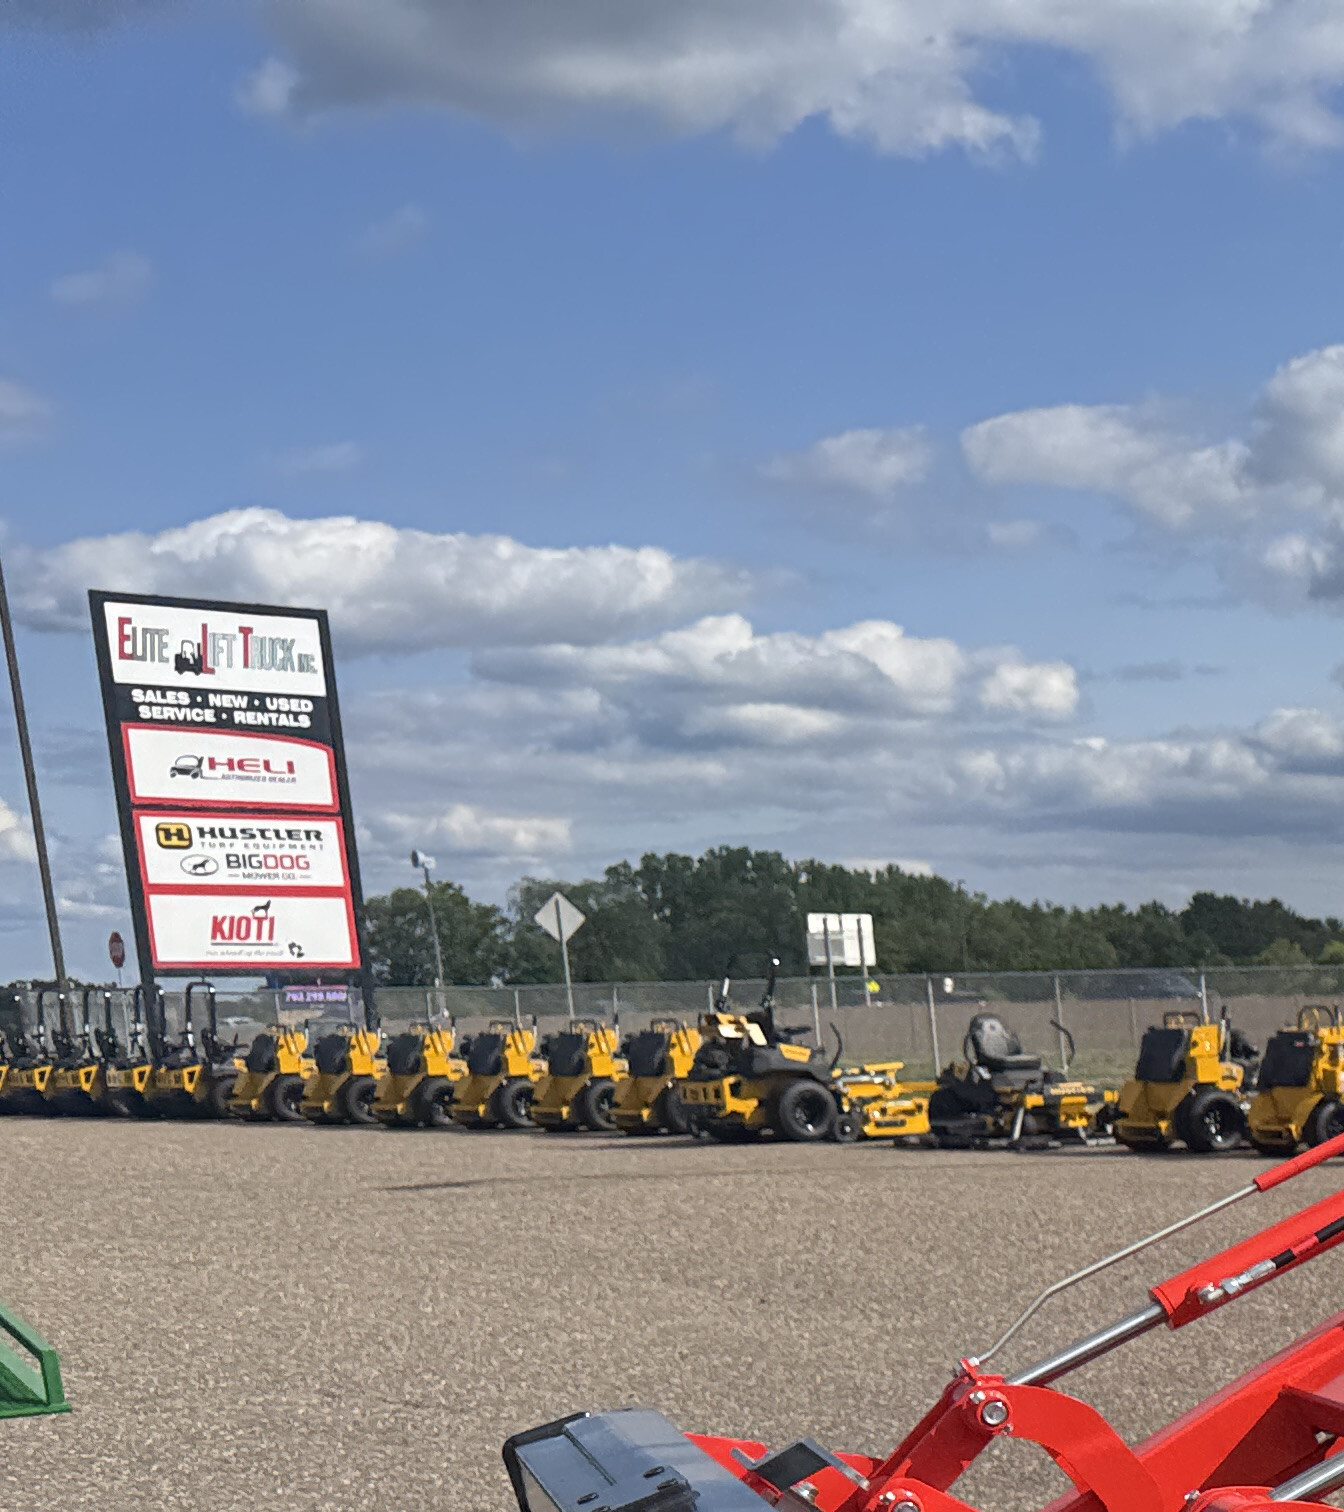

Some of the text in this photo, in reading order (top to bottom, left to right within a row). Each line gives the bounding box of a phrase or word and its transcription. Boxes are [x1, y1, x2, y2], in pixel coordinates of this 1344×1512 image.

[118, 617, 169, 663] ELITE
[201, 623, 236, 675] LIFT
[238, 626, 296, 672] TRUCK
[131, 688, 314, 713] SALES NEW USED
[139, 705, 311, 728] SERVICE RENTALS
[208, 756, 295, 774] HELI
[196, 826, 323, 842] HUSTLER
[226, 853, 310, 870] BIGDOG
[211, 915, 275, 942] KIOTI
